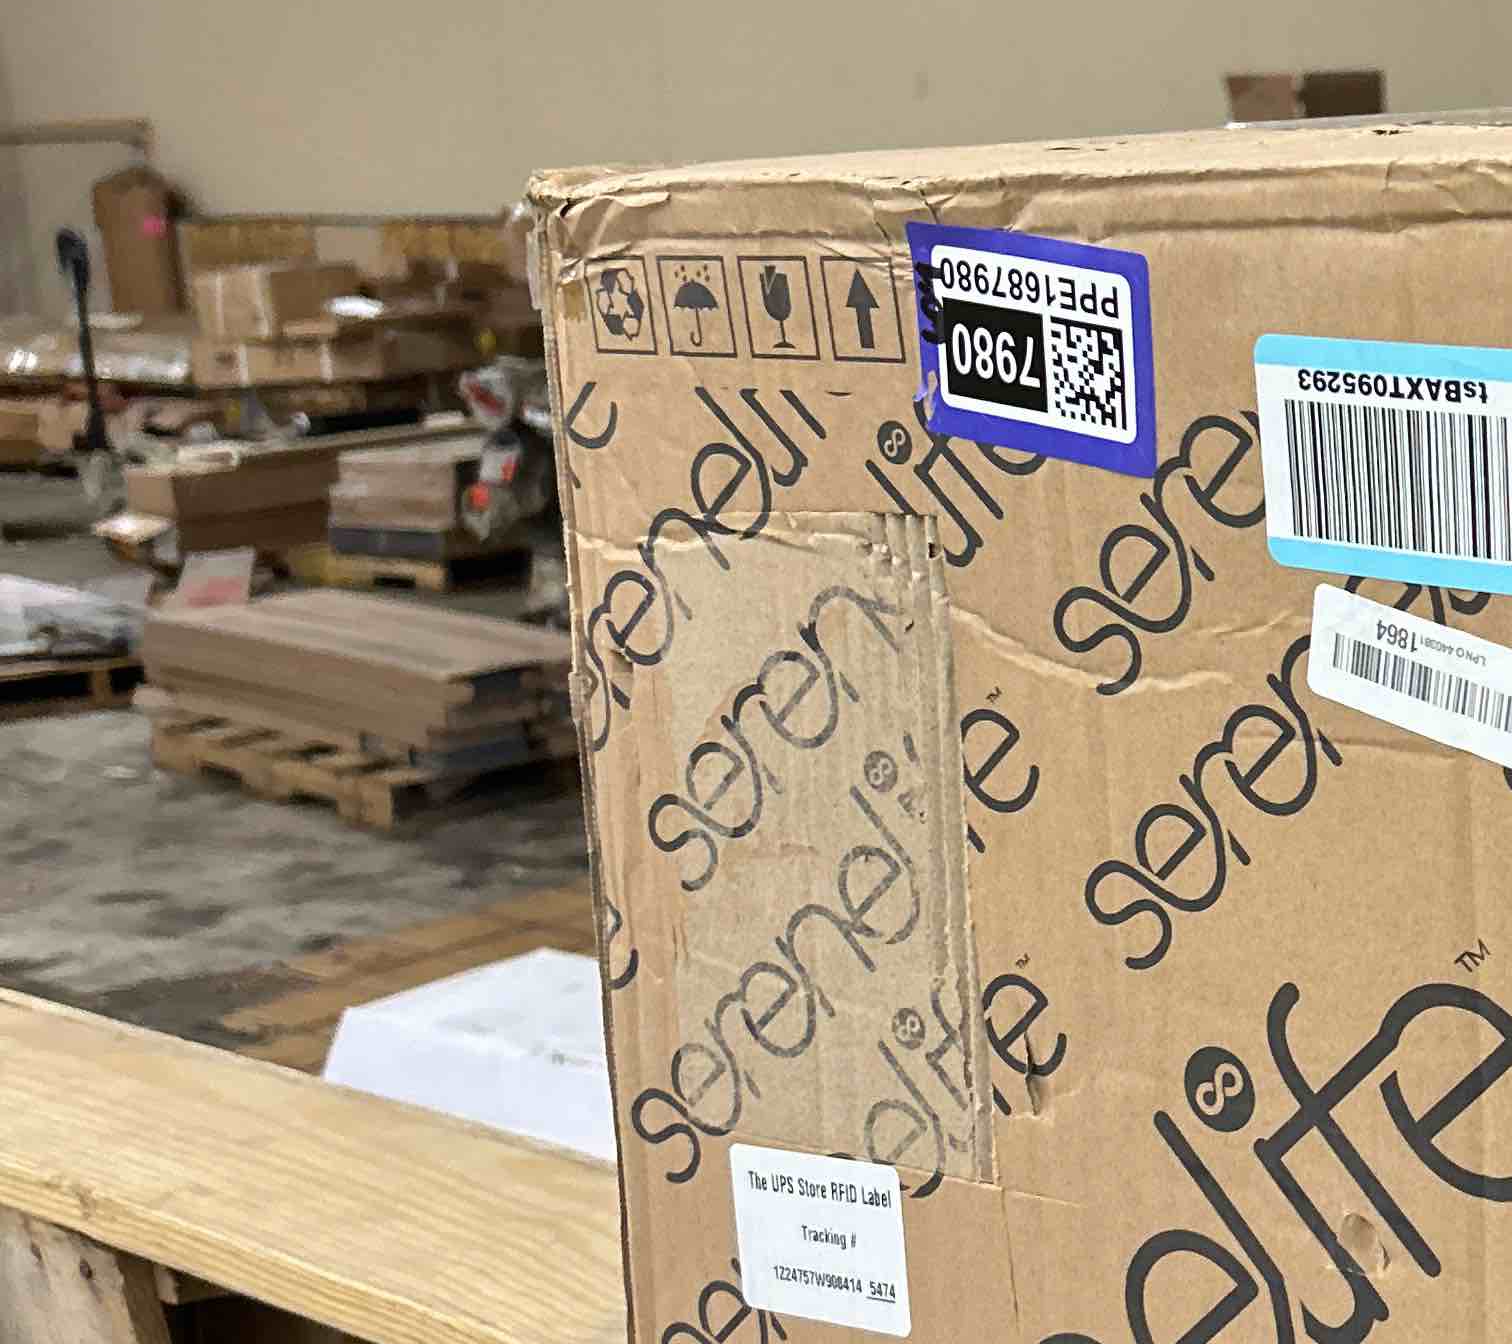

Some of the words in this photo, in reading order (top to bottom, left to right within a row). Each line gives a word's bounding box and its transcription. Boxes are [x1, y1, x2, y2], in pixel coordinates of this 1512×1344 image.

[940, 257, 1119, 319] PPE1687980
[952, 322, 1041, 388] 7980
[1297, 368, 1488, 404] tsBAXT095293
[748, 1170, 768, 1191] The
[771, 1173, 794, 1194] UPS
[798, 1177, 827, 1199] Store
[830, 1182, 857, 1203] RFID
[861, 1186, 892, 1208] Label
[801, 1224, 846, 1250] Tracking
[850, 1232, 857, 1248] #
[869, 1280, 896, 1299] 5474
